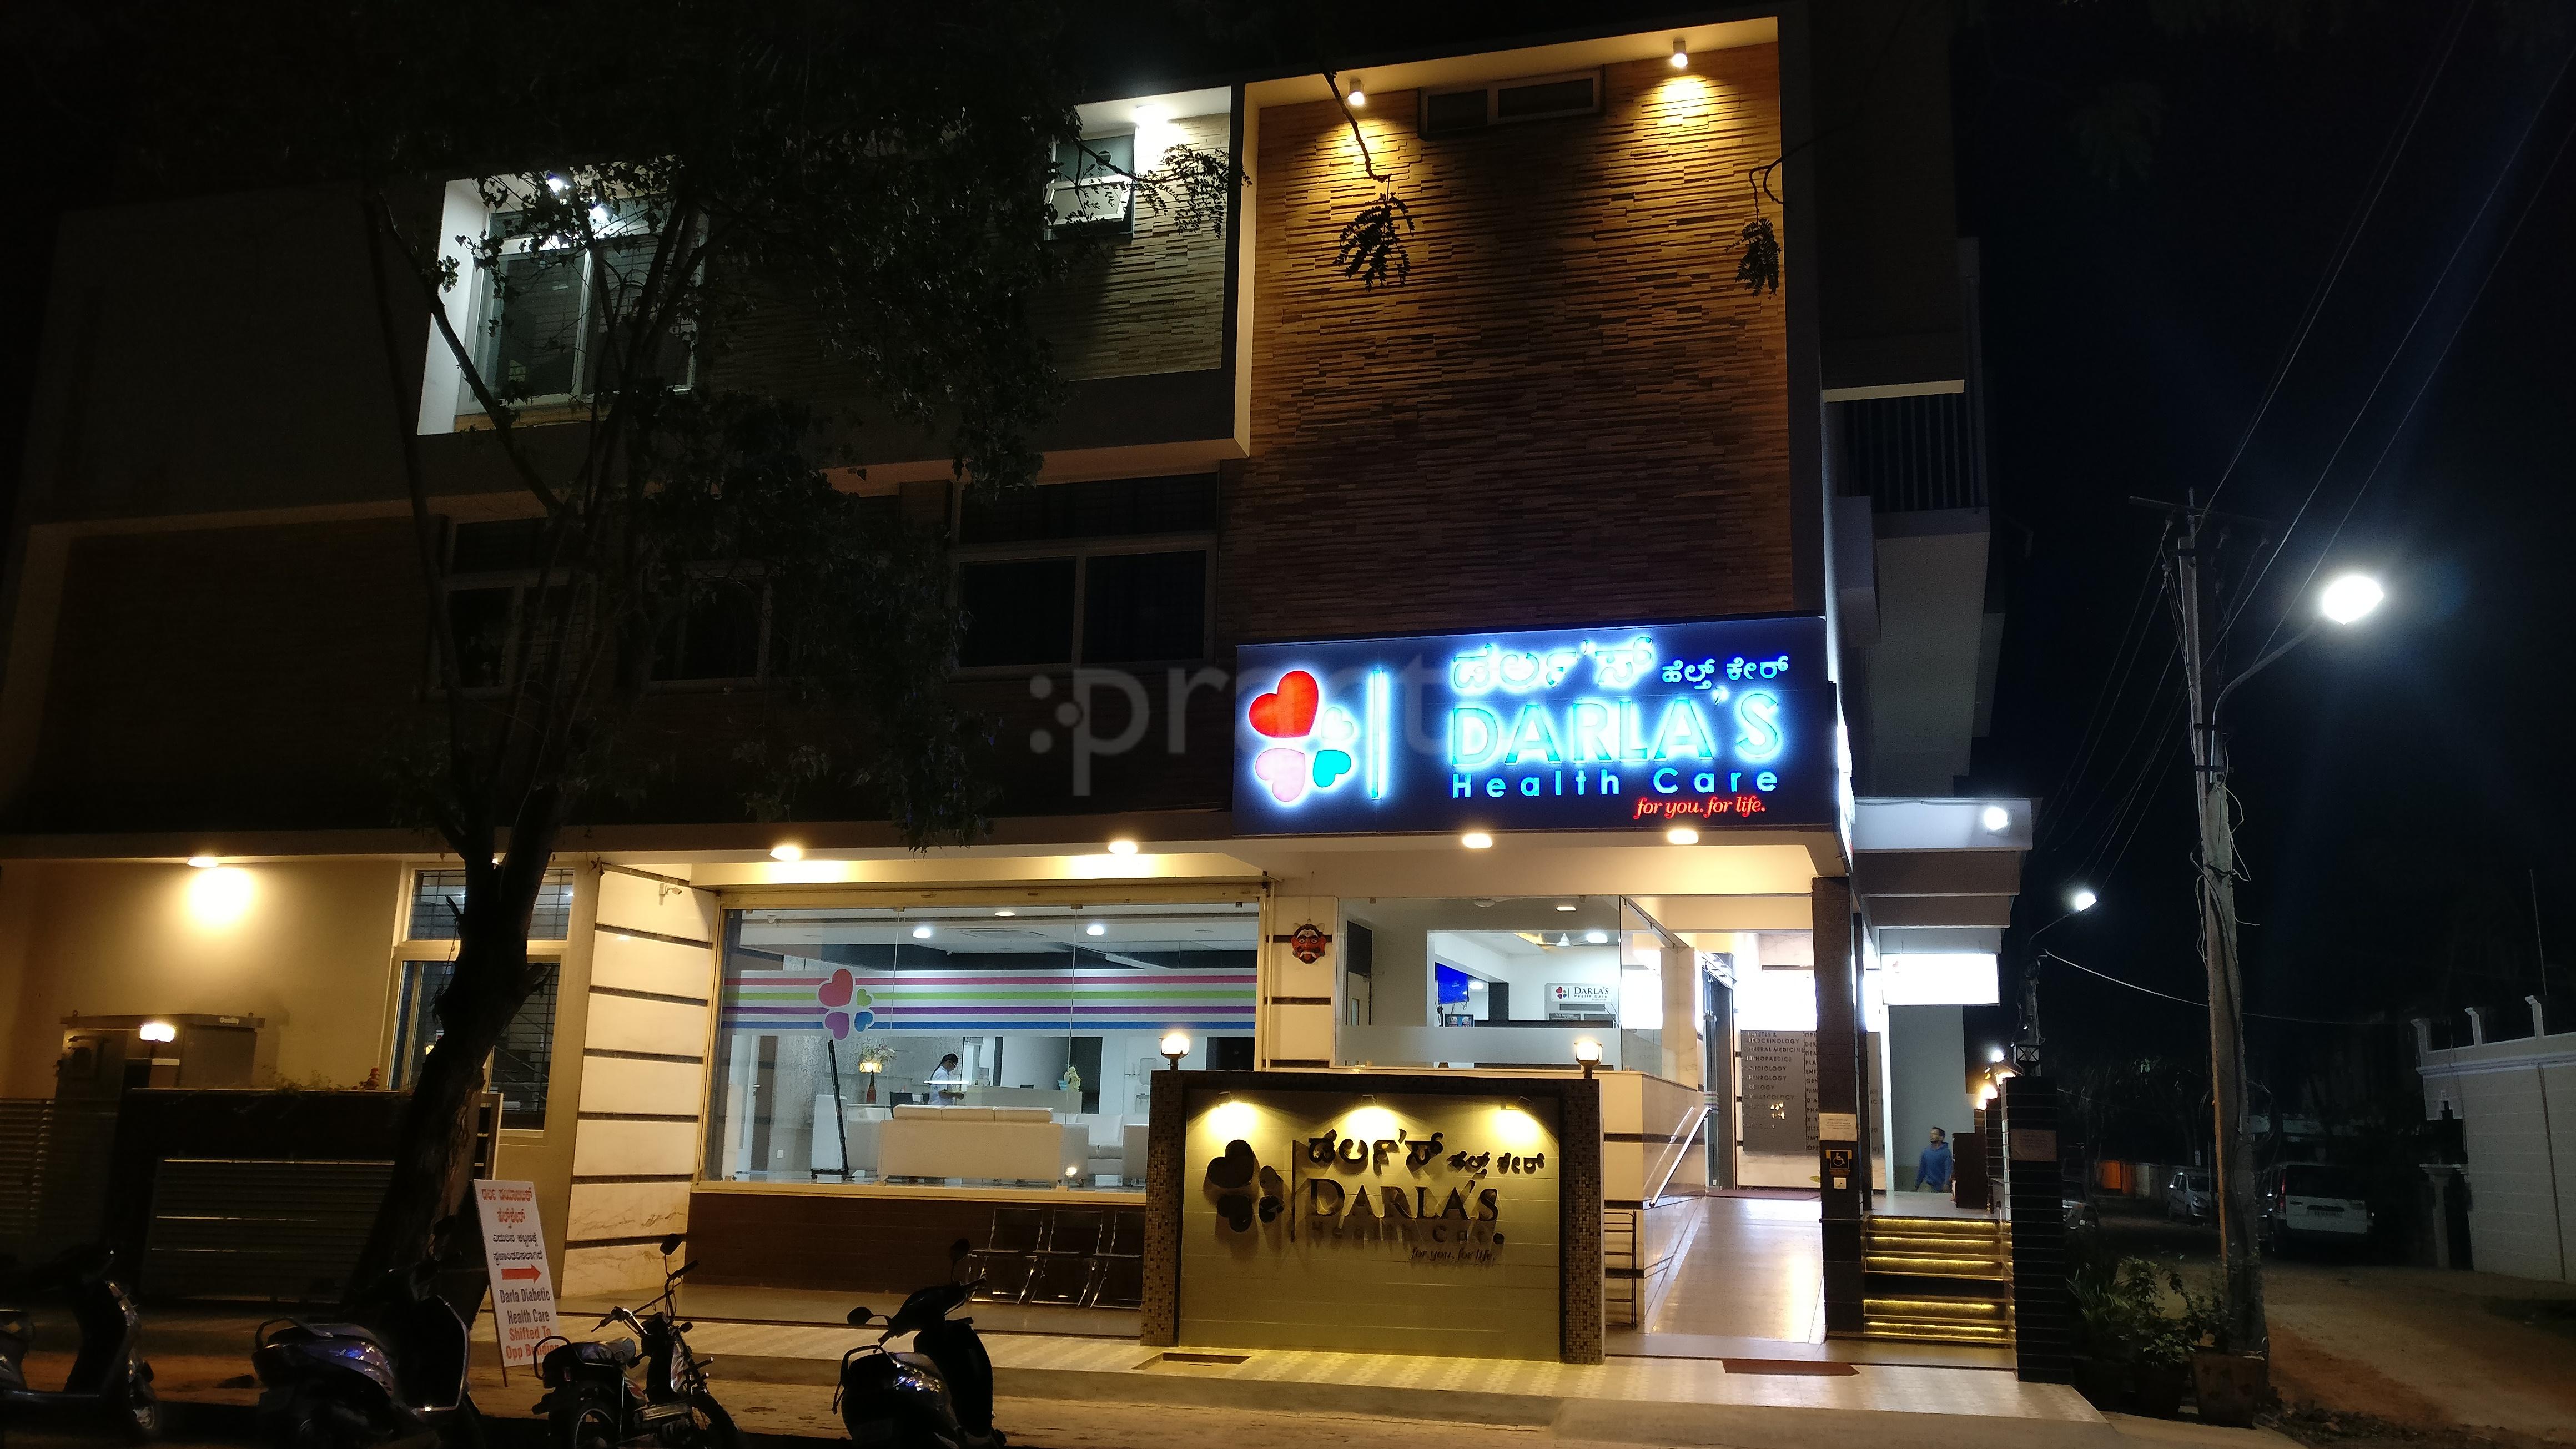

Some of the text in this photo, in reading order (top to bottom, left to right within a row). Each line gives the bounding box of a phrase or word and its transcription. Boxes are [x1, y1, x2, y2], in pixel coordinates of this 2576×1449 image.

[1725, 655, 1789, 681] ಕೇರ್
[1452, 689, 1779, 767] DARLA'S
[1452, 767, 1778, 798] Health Care
[1633, 795, 1766, 819] for you. for life.
[1306, 1178, 1500, 1222] DARLA'S
[1409, 1247, 1428, 1261] for
[499, 1287, 551, 1303] Darla Diabetic
[507, 1308, 550, 1325] Health Care
[509, 1325, 551, 1341] Shifted To
[506, 1345, 523, 1361] Opp
